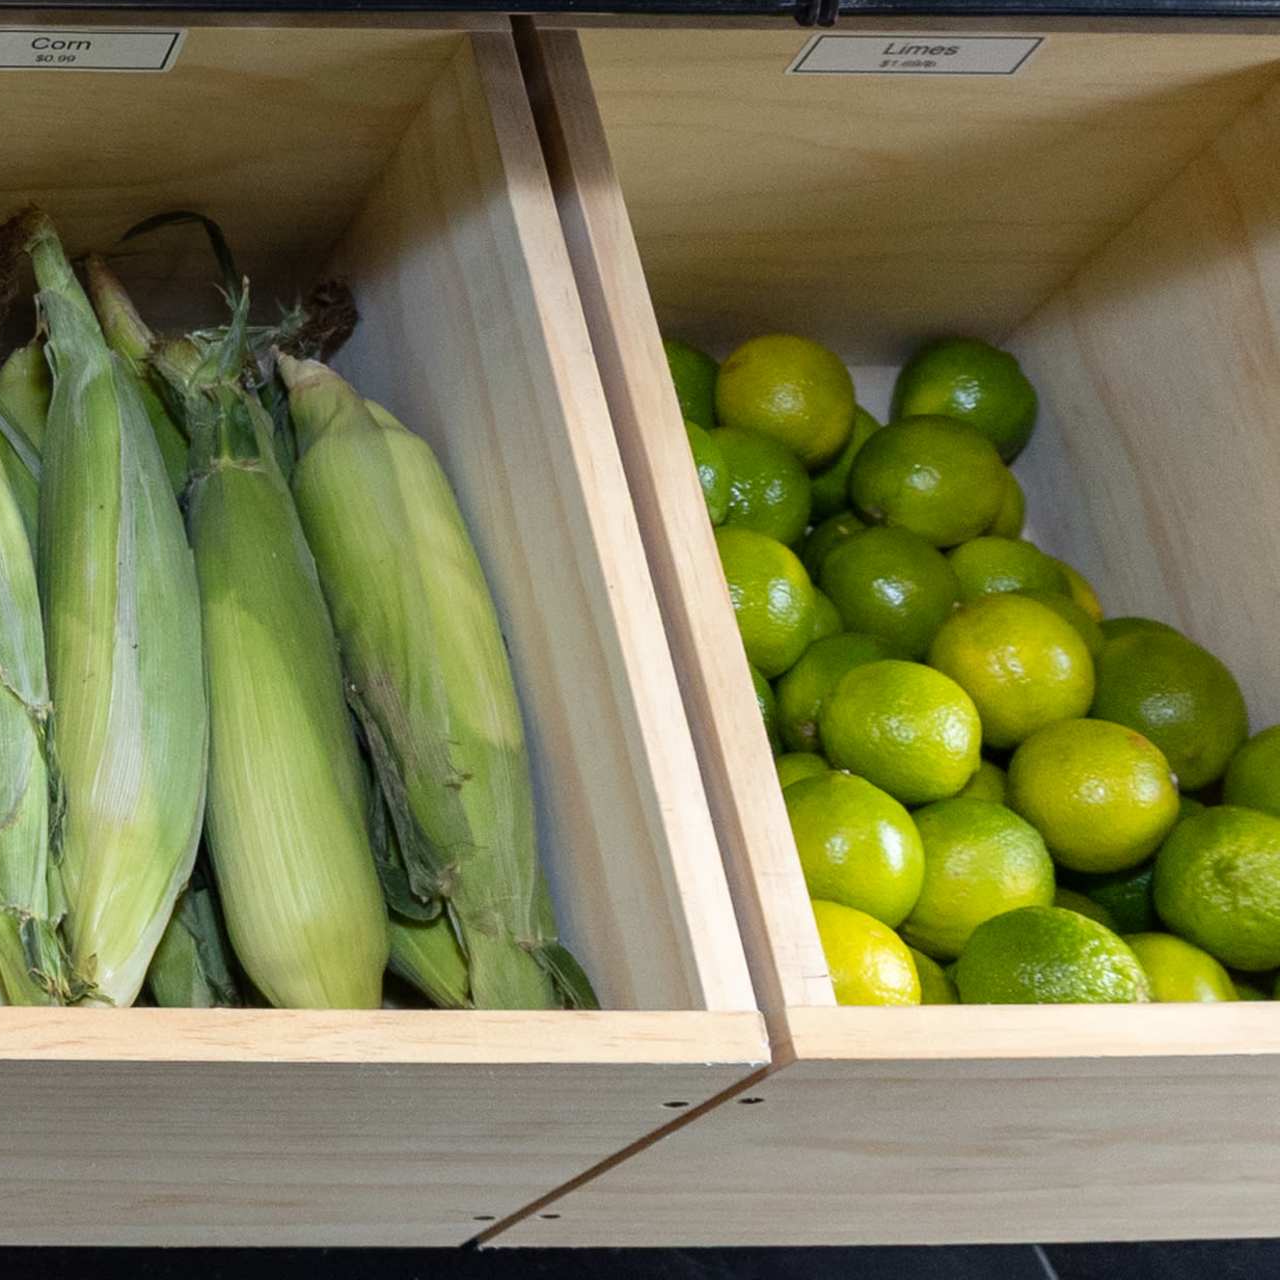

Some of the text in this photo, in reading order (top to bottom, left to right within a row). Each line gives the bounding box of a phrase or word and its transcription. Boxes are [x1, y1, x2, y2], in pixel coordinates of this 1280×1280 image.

[31, 37, 92, 50] Corn
[882, 43, 959, 56] Limes
[35, 54, 76, 62] $0.99
